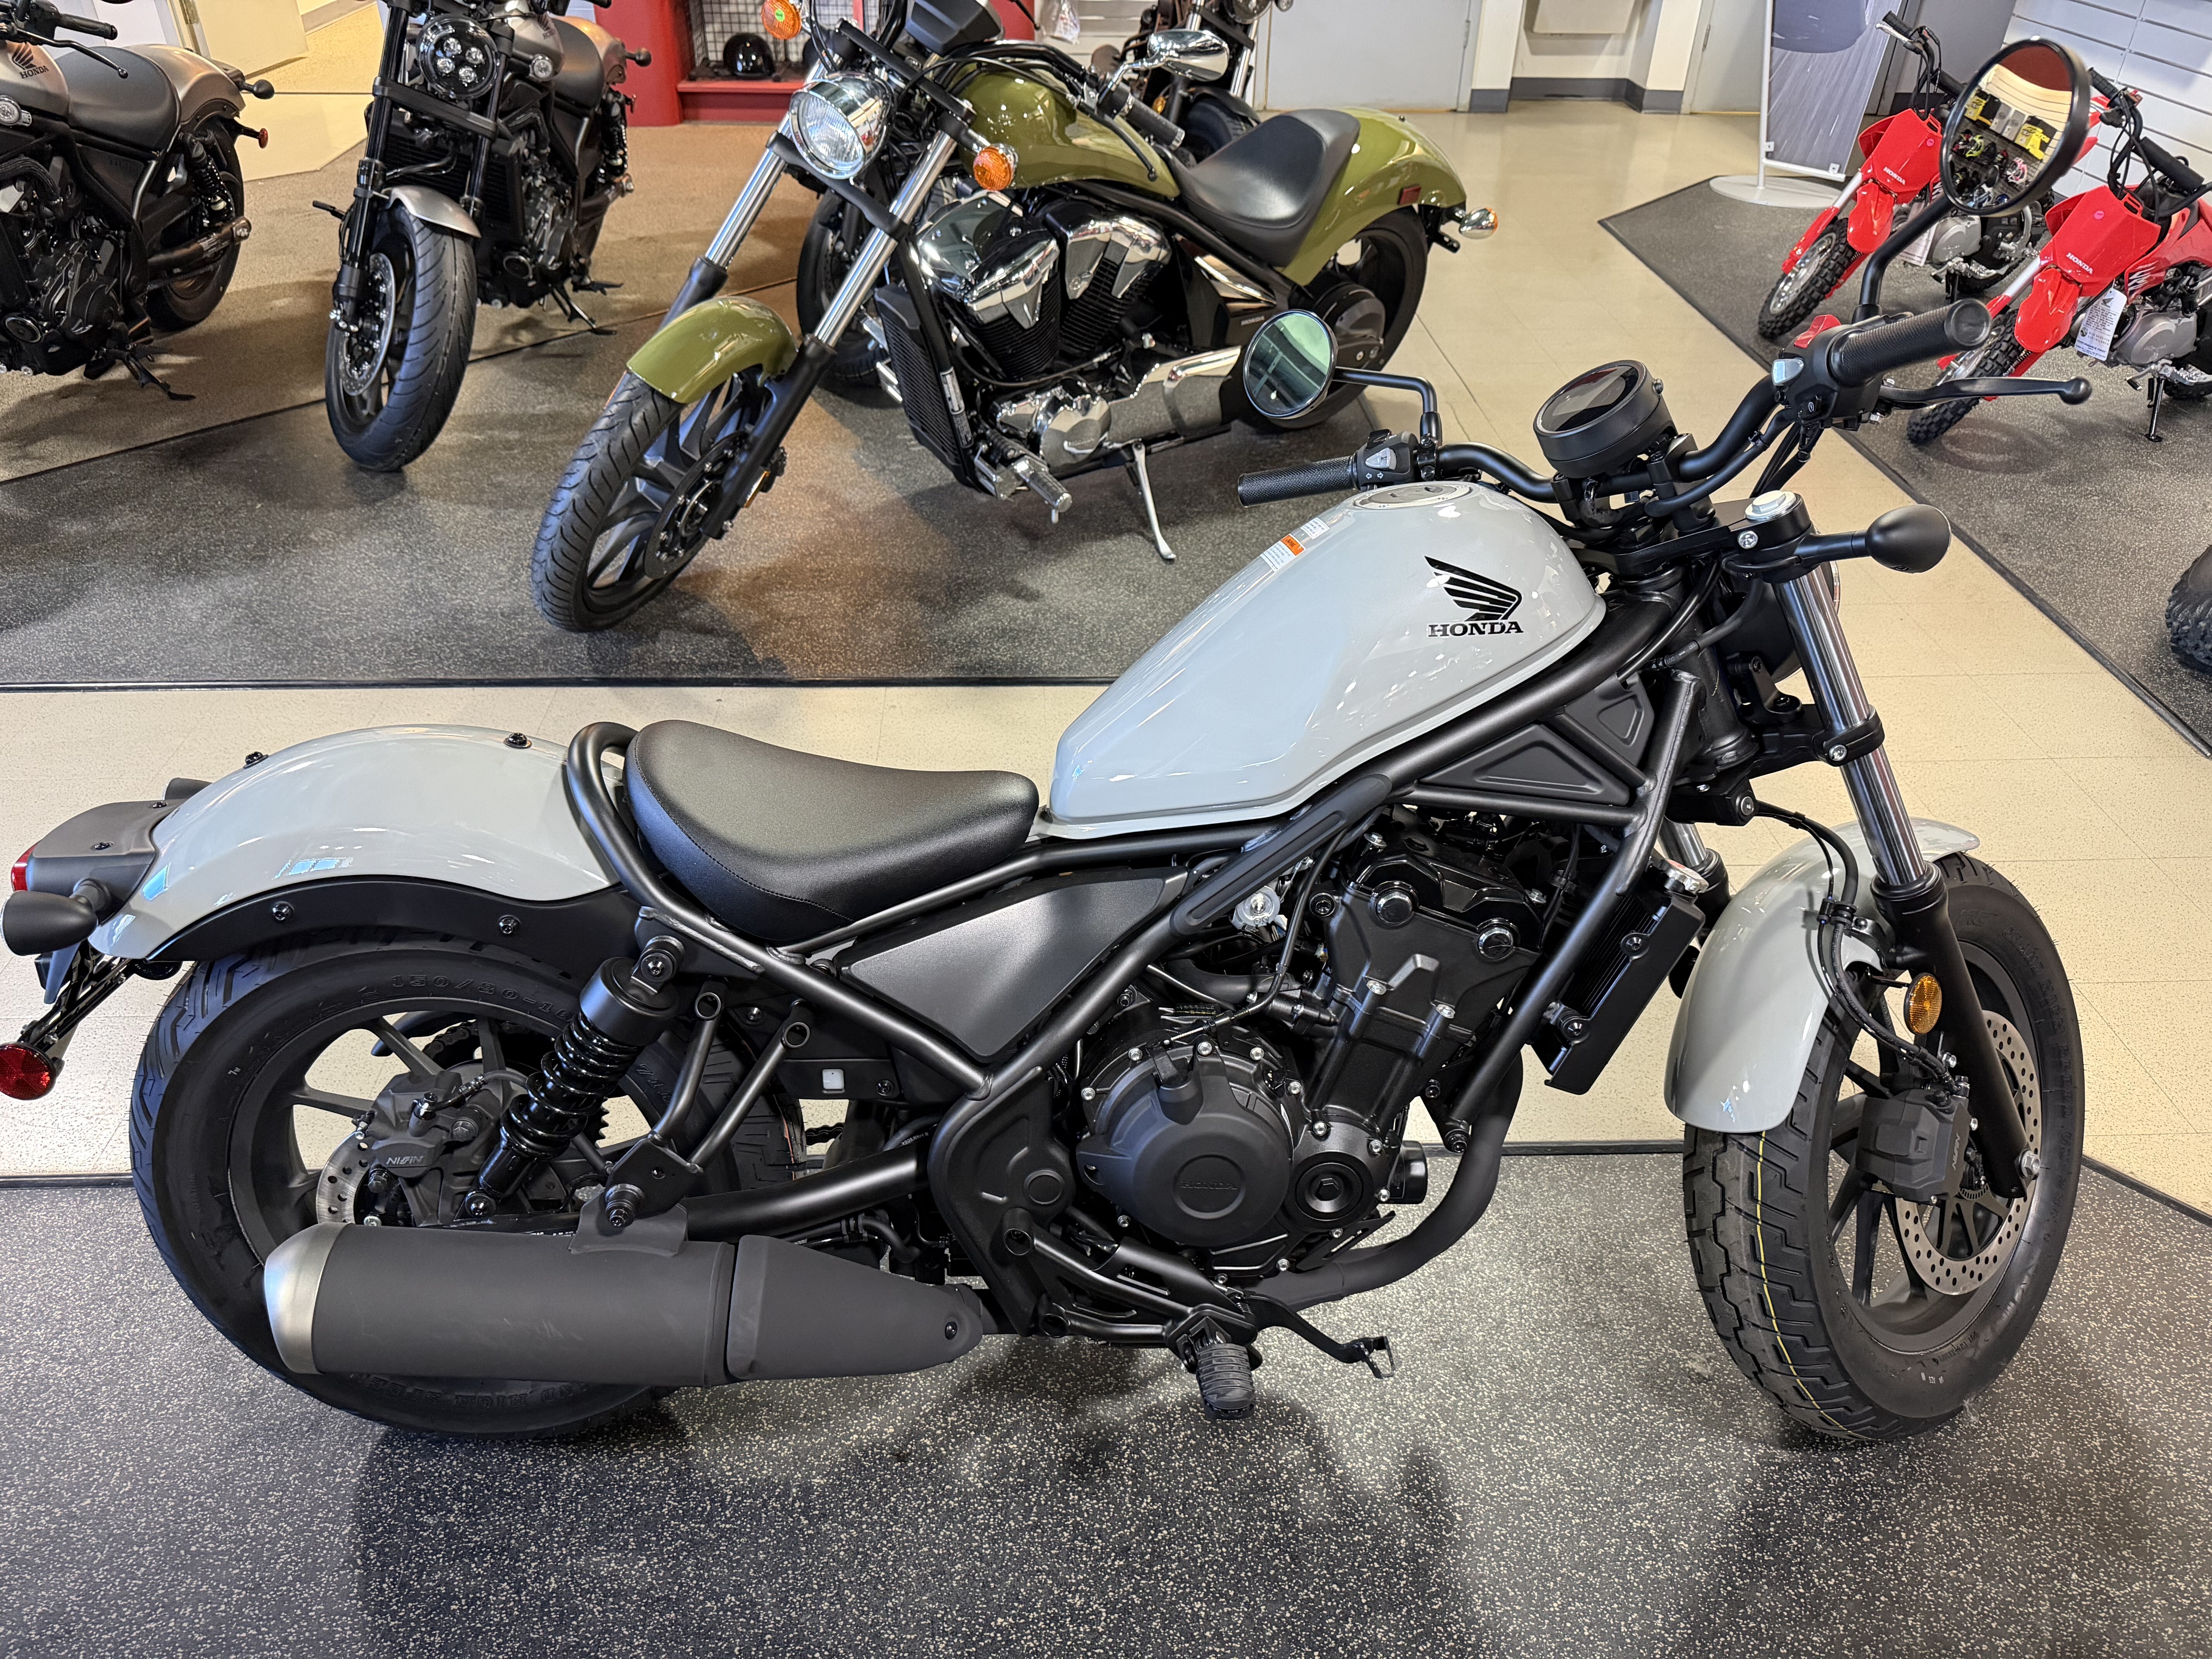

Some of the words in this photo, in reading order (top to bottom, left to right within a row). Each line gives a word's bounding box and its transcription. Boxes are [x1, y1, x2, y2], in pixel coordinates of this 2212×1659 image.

[20, 65, 49, 79] HONDA
[1883, 167, 1905, 185] HONDA
[2066, 252, 2093, 274] HONDA
[1429, 621, 1524, 637] HONDA
[386, 1155, 424, 1165] NISSIN
[1180, 1181, 1238, 1190] HONDA
